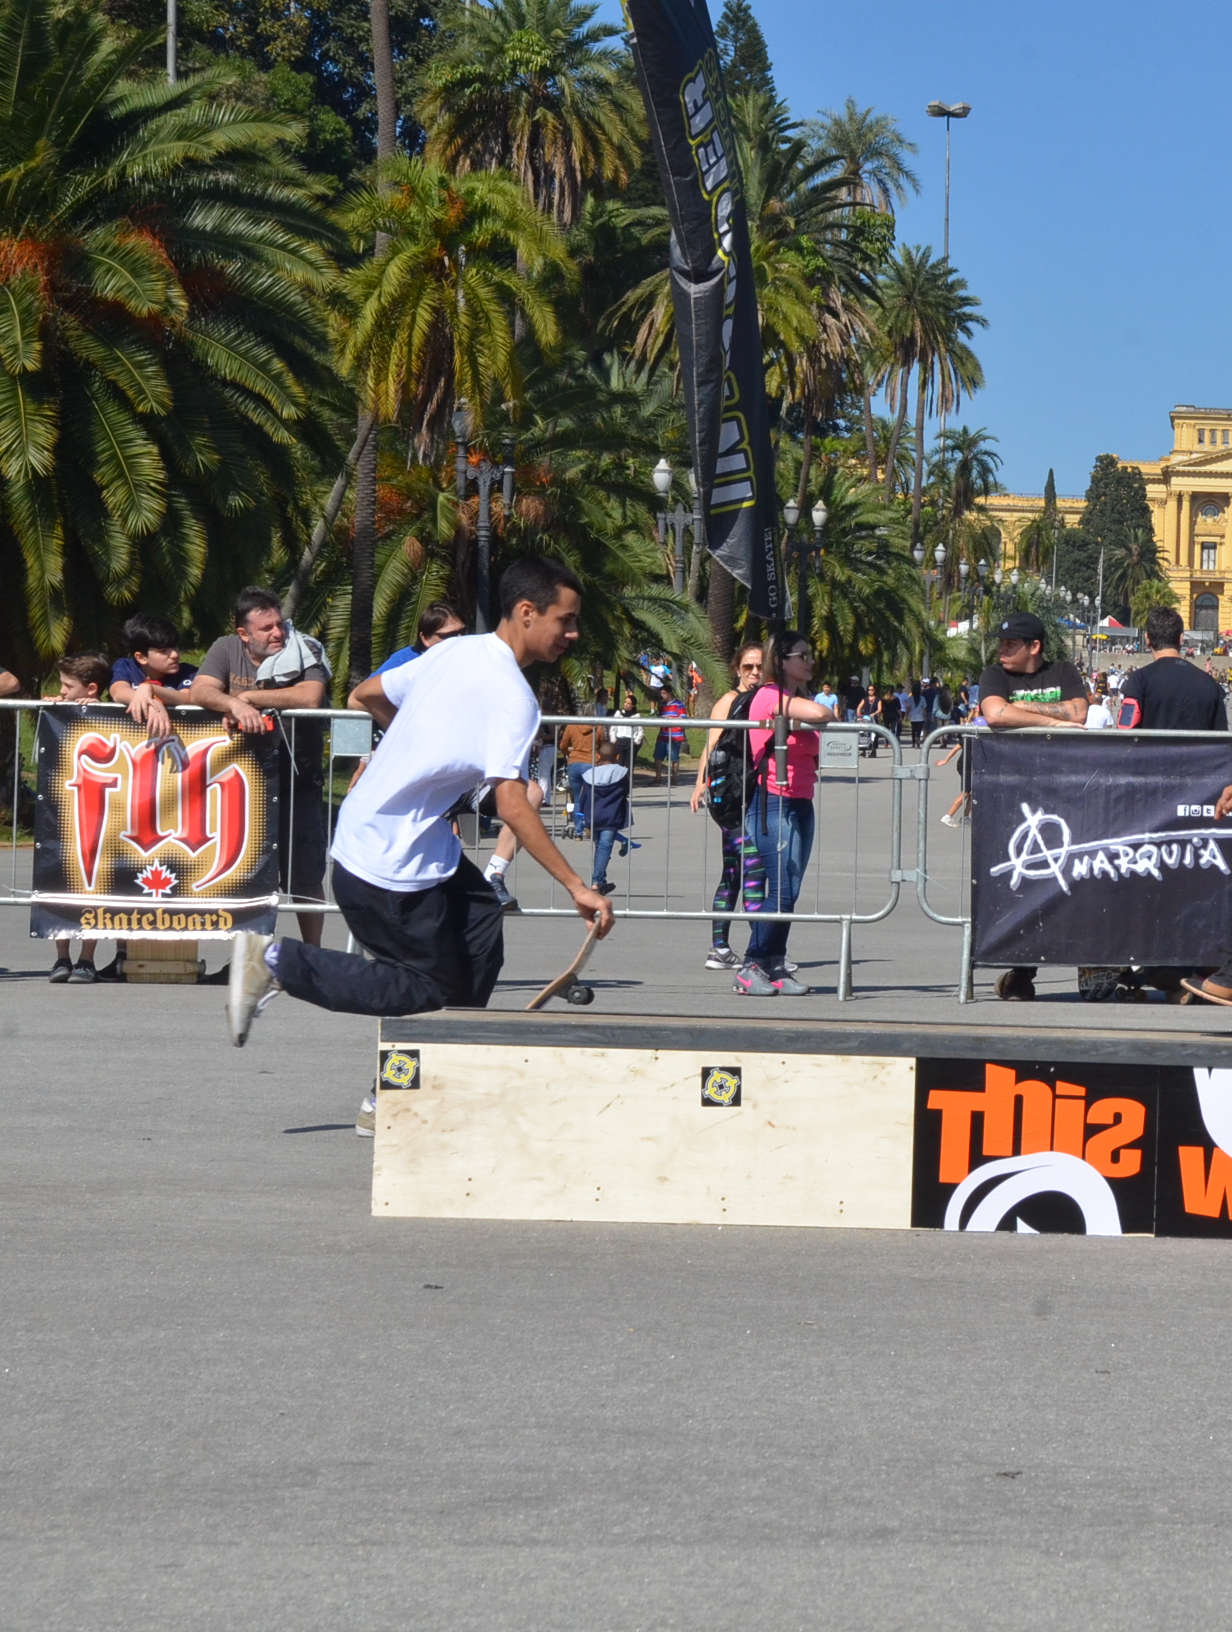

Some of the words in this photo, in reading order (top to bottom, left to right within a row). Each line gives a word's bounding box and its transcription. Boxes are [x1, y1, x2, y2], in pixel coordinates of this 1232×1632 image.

[764, 526, 776, 581] SKATE!
[768, 585, 778, 607] GO
[80, 907, 233, 931] skateboard
